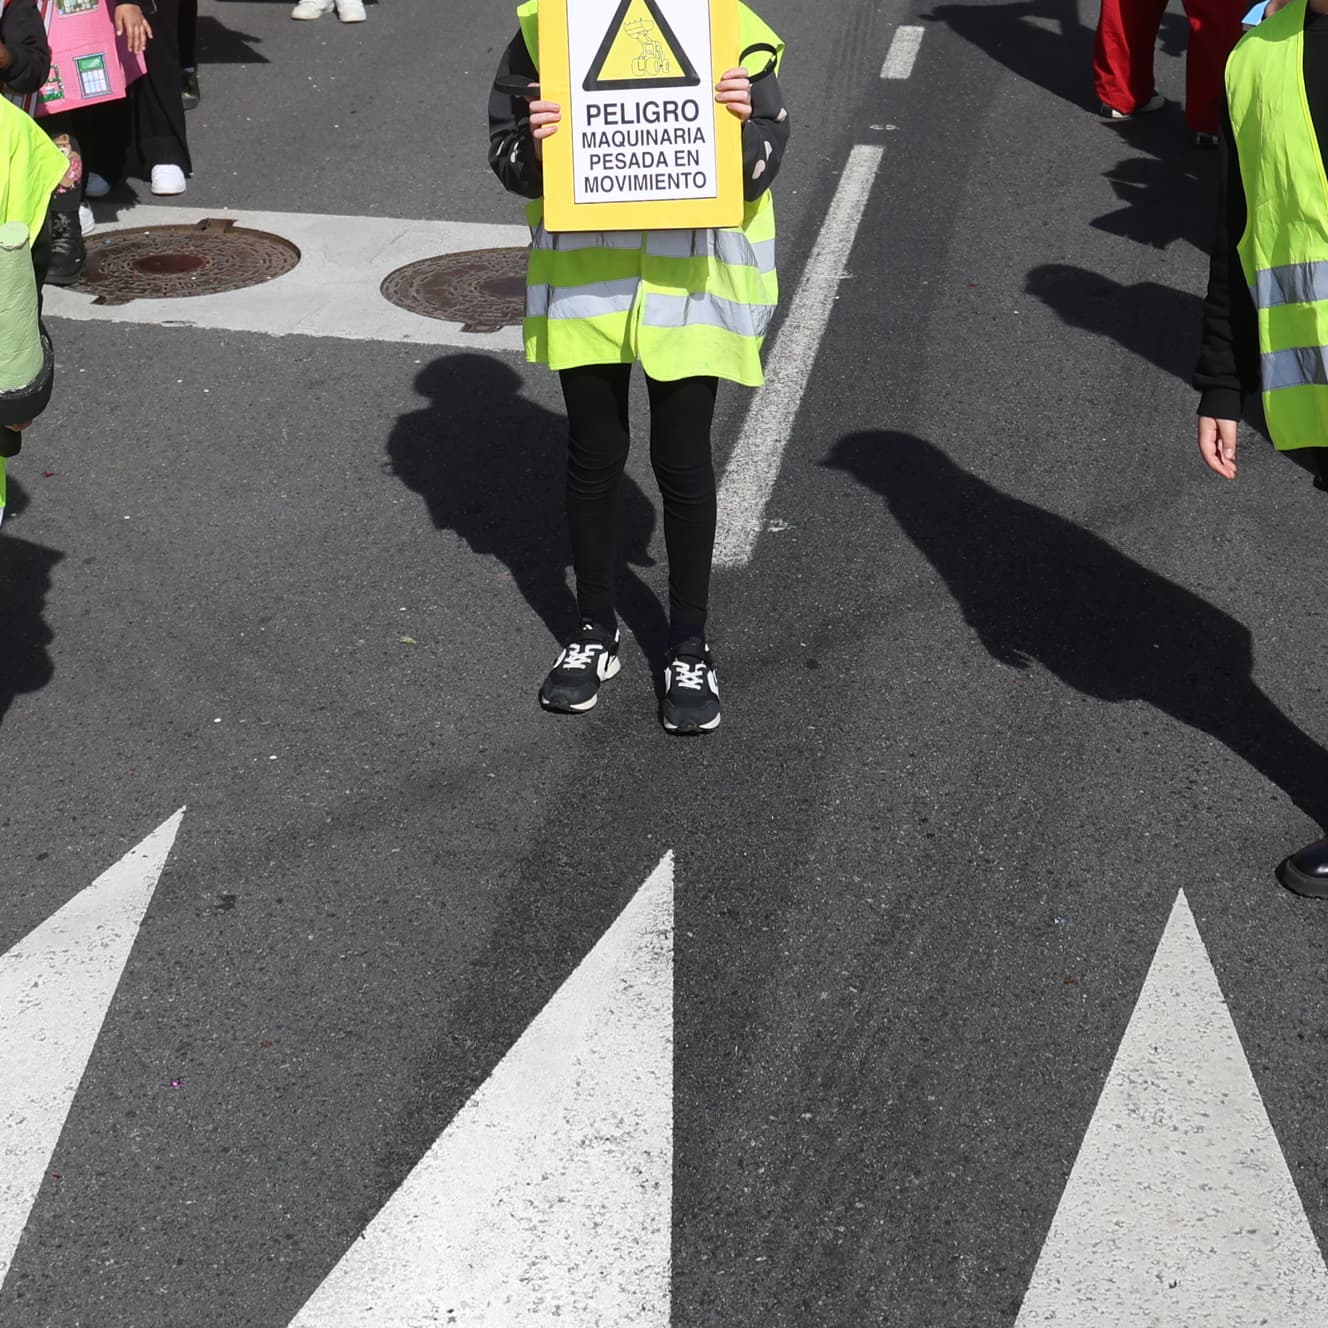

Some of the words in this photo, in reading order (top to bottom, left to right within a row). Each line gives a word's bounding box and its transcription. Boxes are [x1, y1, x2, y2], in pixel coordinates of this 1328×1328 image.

[586, 99, 699, 126] PELIGRO
[582, 127, 706, 149] MAQUINARIA
[589, 151, 669, 171] PESADA
[674, 149, 700, 167] EN
[584, 171, 707, 193] MOVIMIENTO
